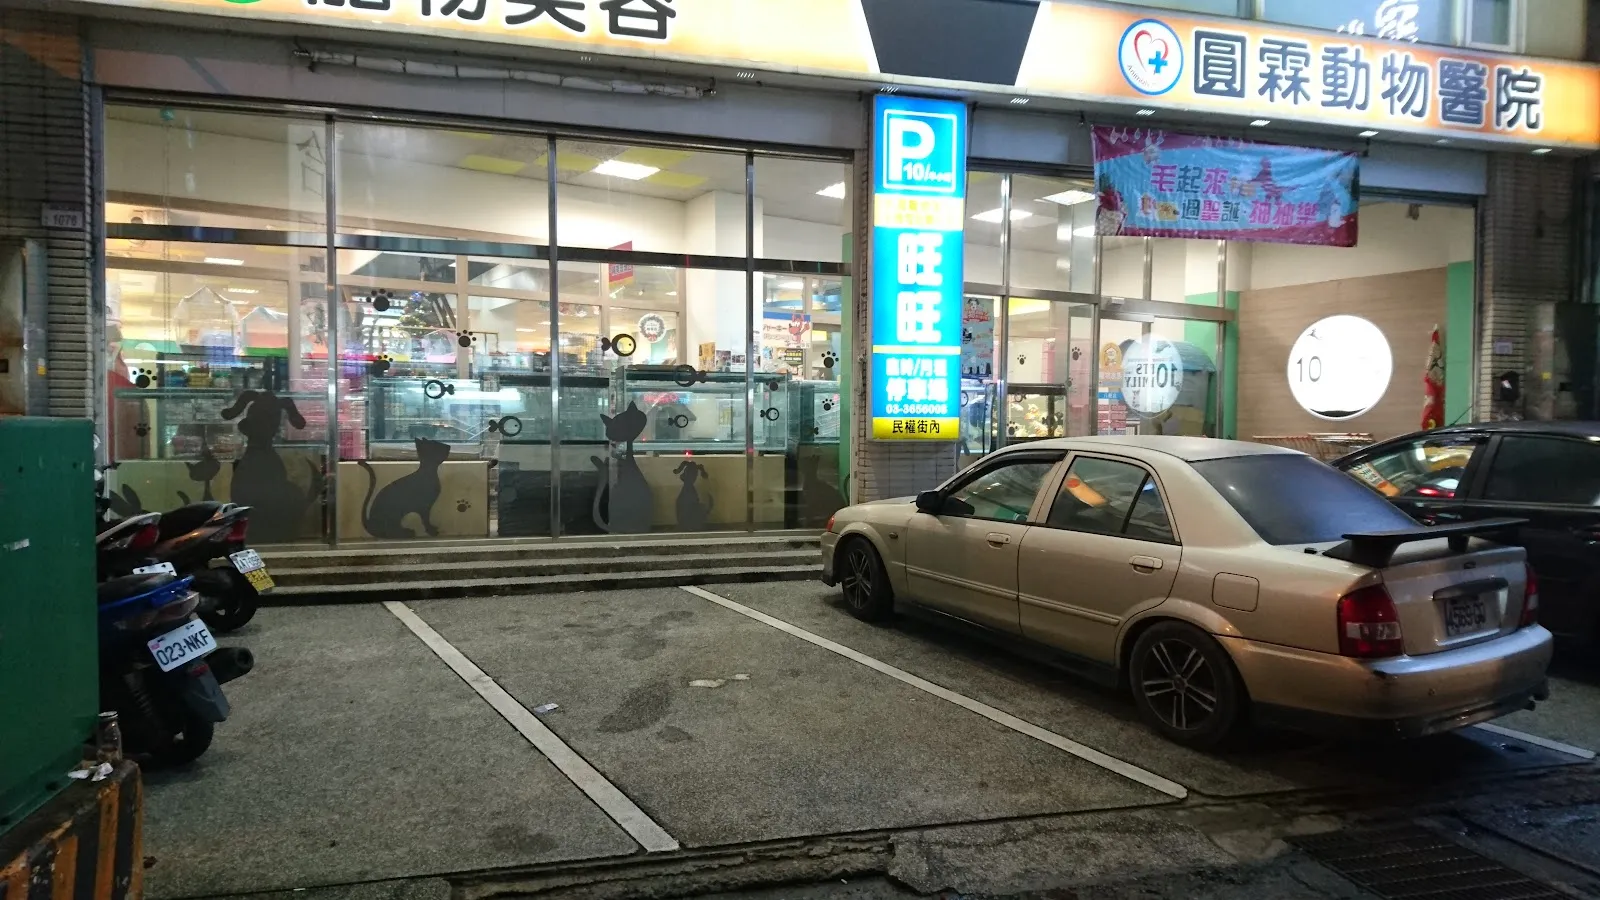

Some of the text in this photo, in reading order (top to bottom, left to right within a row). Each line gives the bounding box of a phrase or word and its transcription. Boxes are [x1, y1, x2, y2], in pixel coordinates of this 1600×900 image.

[1193, 29, 1542, 129] 圓霖動物醫院
[888, 118, 935, 181] P
[1151, 164, 1229, 195] 毛起來
[897, 232, 943, 343] 旺旺
[1296, 355, 1322, 382] 10
[892, 420, 940, 434] 民權街內
[156, 629, 210, 666] 023-NKF
